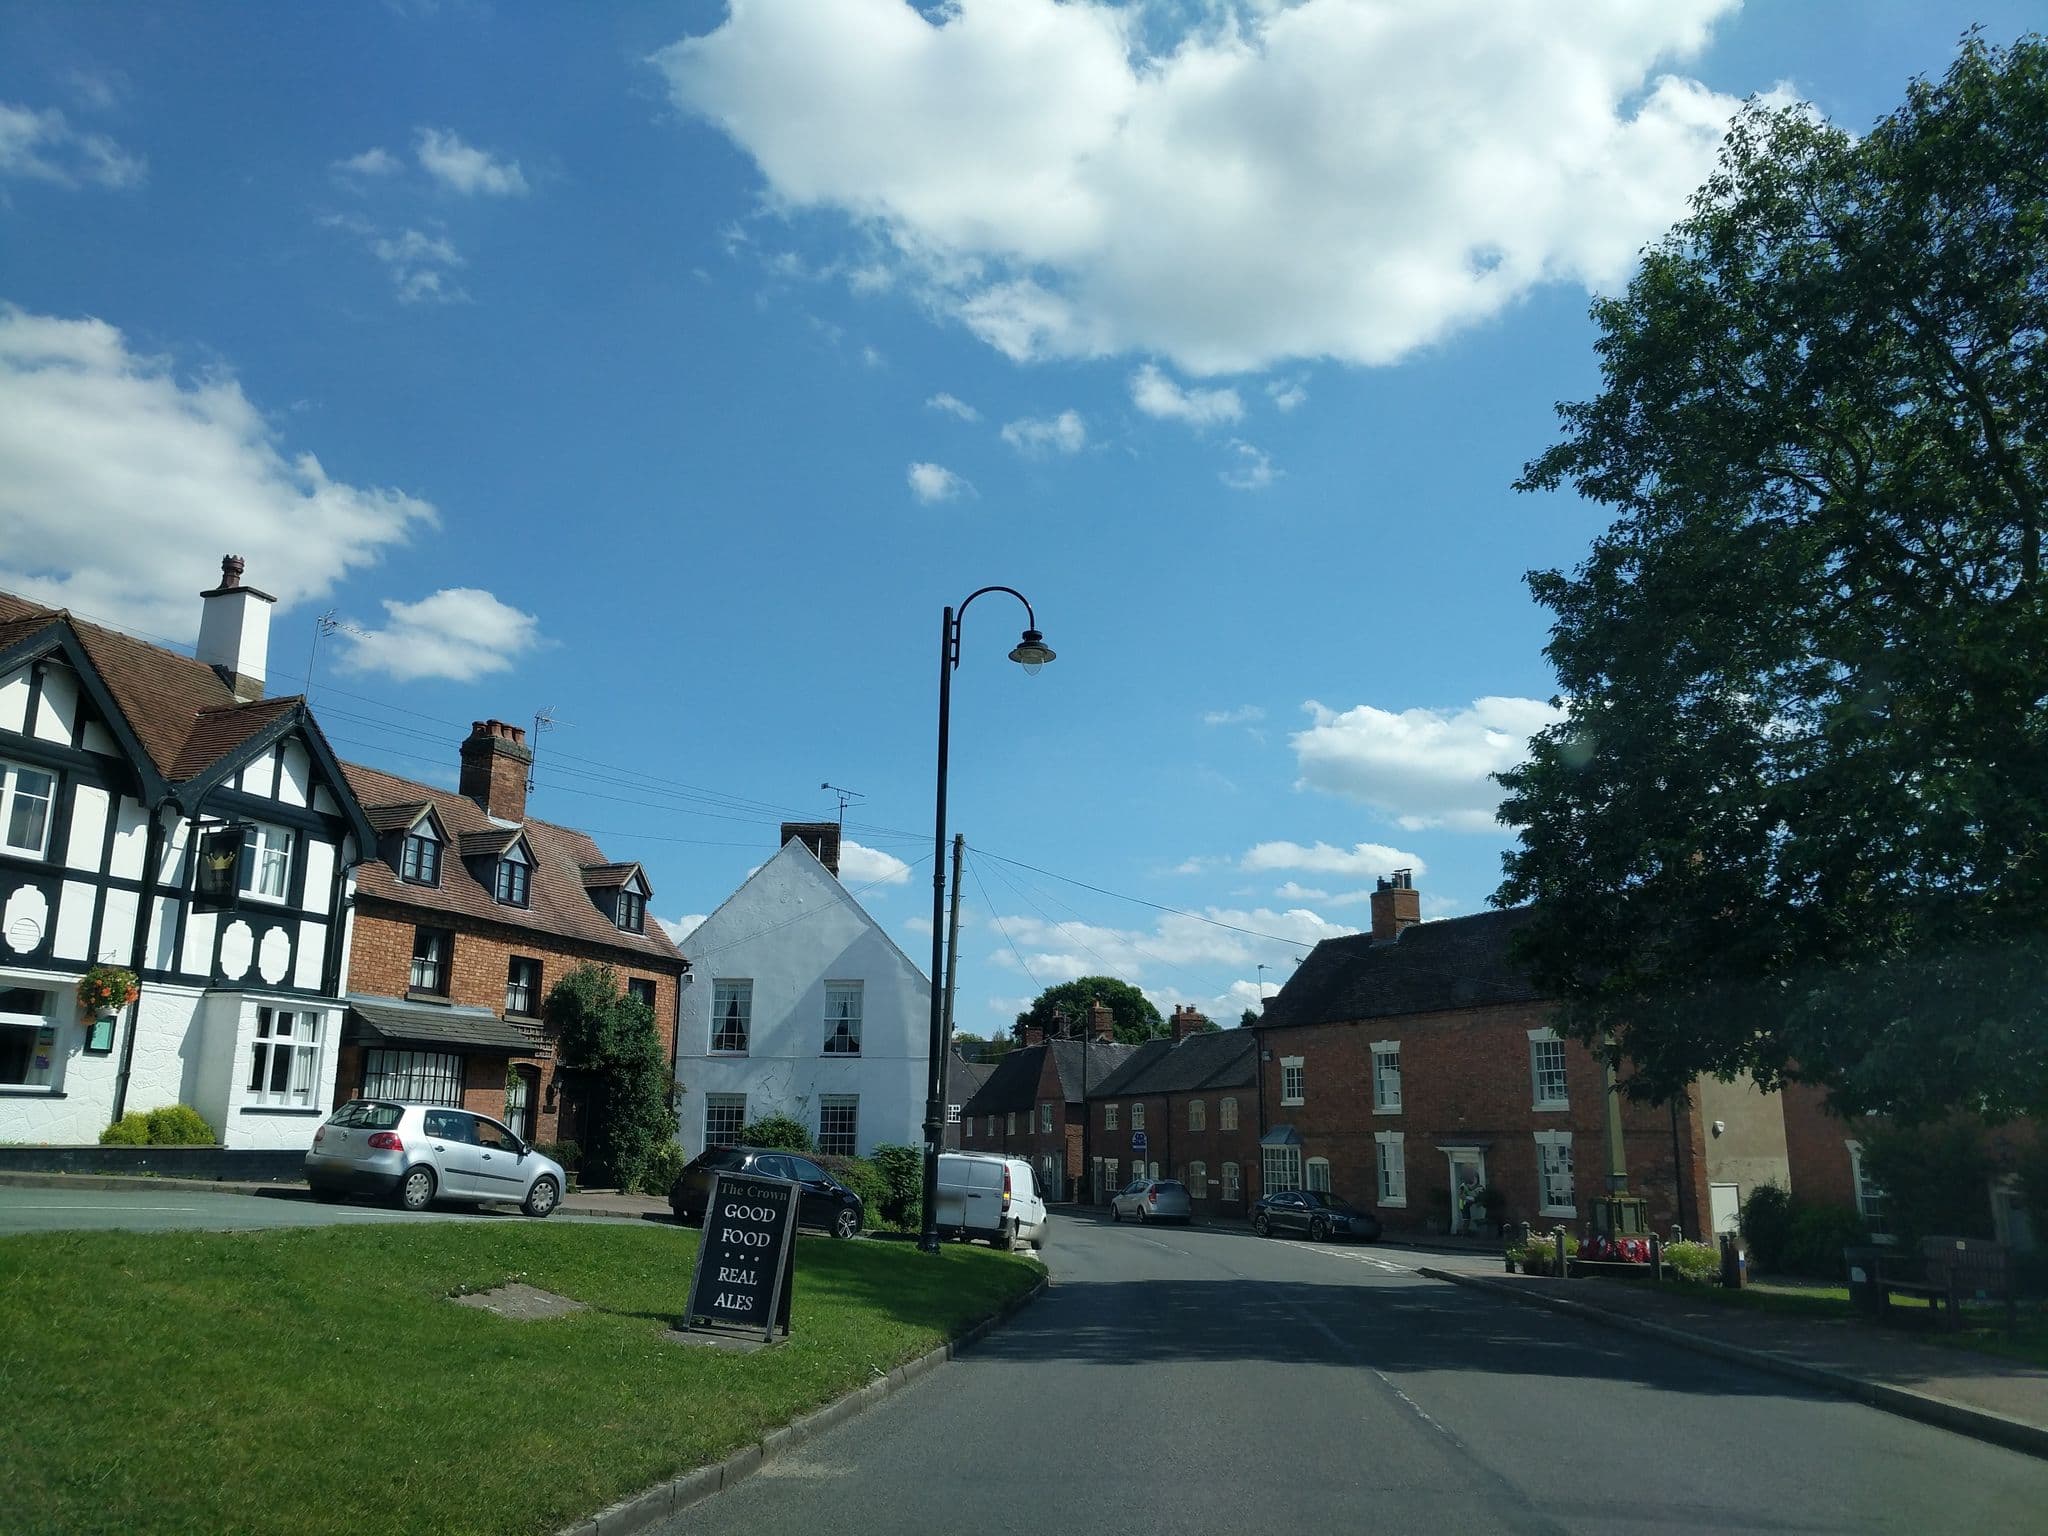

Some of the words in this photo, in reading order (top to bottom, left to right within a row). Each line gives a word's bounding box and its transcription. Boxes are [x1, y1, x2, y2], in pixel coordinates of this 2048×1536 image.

[720, 1182, 744, 1196] The
[747, 1185, 787, 1201] Crown
[724, 1203, 776, 1222] GOOD
[721, 1228, 770, 1247] FOOD
[717, 1267, 758, 1285] REAL
[714, 1292, 753, 1311] ALES
